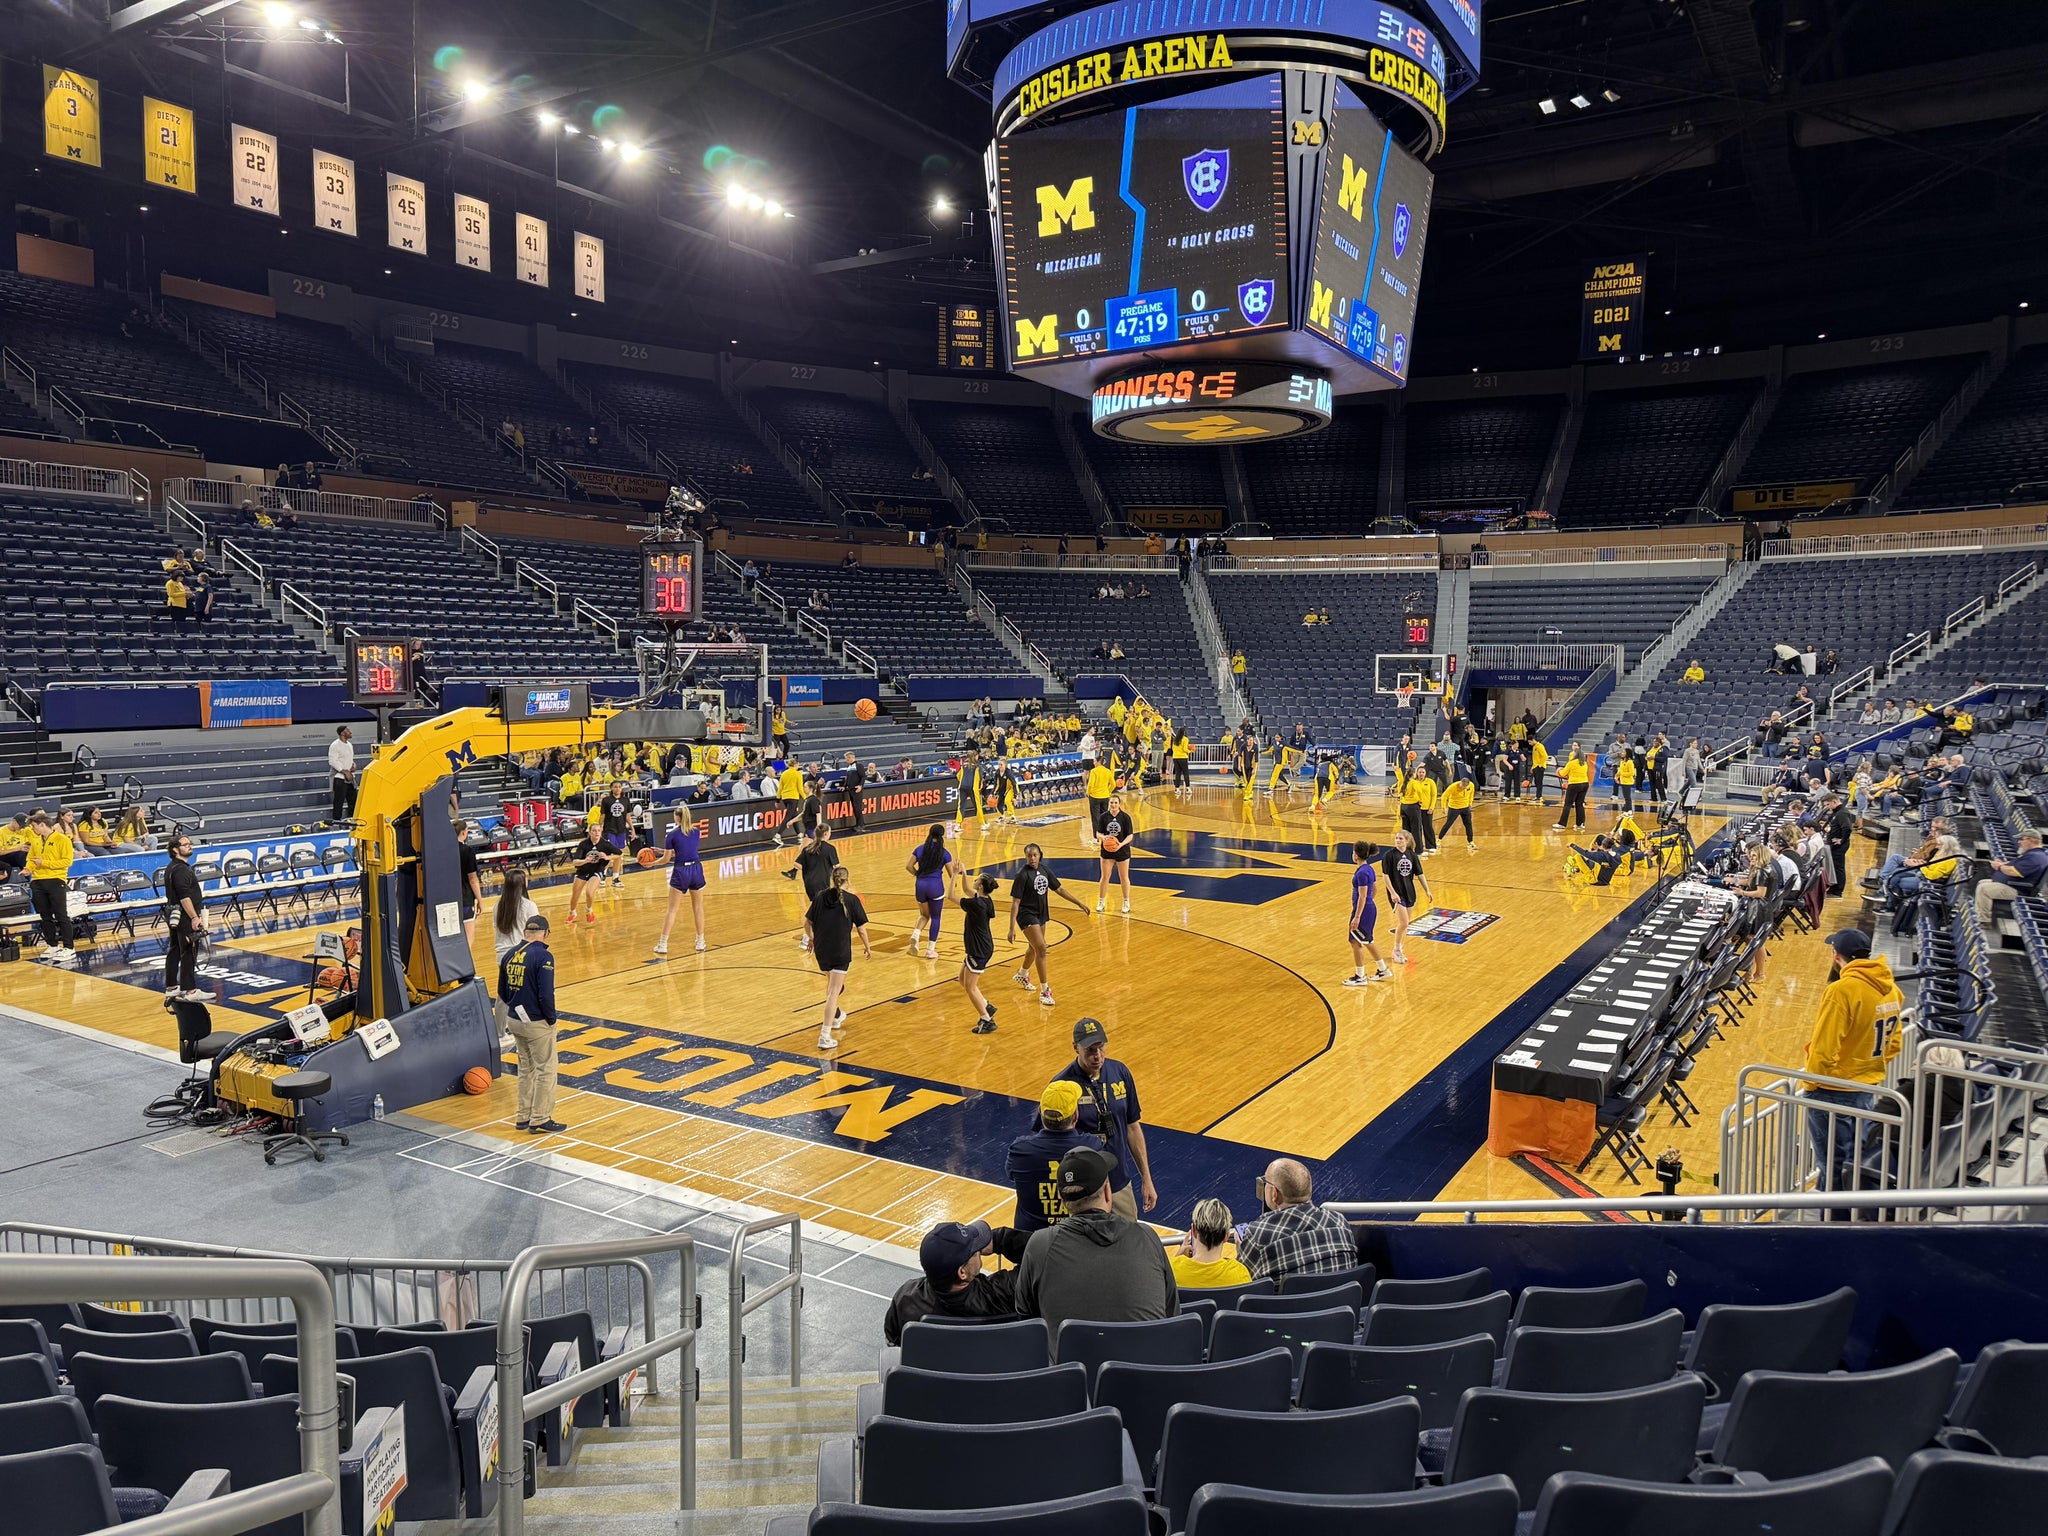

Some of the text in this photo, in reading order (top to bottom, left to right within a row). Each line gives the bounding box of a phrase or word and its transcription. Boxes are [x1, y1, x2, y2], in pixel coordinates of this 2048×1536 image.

[1020, 34, 1233, 117] CRISLER ARENA
[1370, 48, 1438, 113] CRISLER
[49, 80, 95, 101] FLAHERTY
[66, 98, 78, 116] 3
[157, 111, 181, 126] DIETZ
[160, 127, 178, 147] 21
[1292, 120, 1322, 145] M
[67, 145, 81, 158] M
[240, 136, 270, 153] BUNTIN
[246, 152, 266, 172] 22
[319, 162, 350, 178] RUSSELL
[164, 172, 178, 185] M
[326, 176, 344, 195] 33
[1337, 152, 1368, 222] M
[250, 196, 263, 208] M
[398, 198, 416, 216] 45
[1035, 176, 1096, 238] M
[458, 204, 486, 220] HUBBARD
[330, 218, 342, 229] M
[465, 218, 480, 234] 35
[526, 224, 538, 233] RICE
[402, 238, 414, 248] M
[524, 236, 538, 252] 41
[1181, 232, 1210, 250] HOLY
[1215, 224, 1255, 243] CROSS
[1334, 234, 1360, 261] MICHIGAN
[468, 256, 479, 266] M
[586, 254, 592, 268] 3
[1044, 253, 1101, 274] MICHIGAN
[528, 272, 538, 282] M
[1593, 262, 1634, 279] NCAA
[294, 280, 326, 299] 224
[1384, 270, 1408, 297] HOLY CROSS
[1584, 275, 1642, 292] CHAMPIONS
[586, 288, 594, 297] M
[1192, 289, 1206, 312] 0
[1584, 287, 1642, 299] WOMEN'S GYMNASTICS
[1120, 302, 1163, 318] PREGAME
[1309, 279, 1334, 330] M
[1339, 297, 1346, 318] 0
[428, 312, 460, 329] 225
[1076, 308, 1090, 330] 0
[1185, 316, 1210, 326] FOULS
[1594, 306, 1630, 324] 2021
[952, 320, 982, 328] CHAMPIONS
[1115, 313, 1168, 337] 47:19
[1190, 325, 1206, 335] TOL
[1015, 314, 1059, 357] M
[1070, 334, 1092, 344] FOULS
[1134, 335, 1151, 344] POSS
[1352, 323, 1372, 348] 47:19
[1380, 324, 1386, 342] 0
[1074, 344, 1089, 352] TOL
[1598, 334, 1622, 352] M
[1870, 336, 1905, 352] 233
[621, 345, 648, 360] 226
[960, 355, 974, 366] M
[790, 367, 816, 380] 227
[1661, 361, 1692, 375] 232
[963, 382, 990, 394] 228
[1473, 376, 1499, 389] 231
[1093, 370, 1196, 420] MADNESS
[624, 484, 648, 495] UNION
[630, 478, 666, 490] MICHIGAN
[1754, 488, 1794, 504] DTE
[1133, 513, 1216, 525] NISSAN
[650, 554, 692, 573] 47:19
[656, 576, 686, 612] 30
[1406, 618, 1429, 627] 47:19
[1408, 628, 1426, 642] 30
[358, 645, 403, 662] 47:19
[370, 668, 395, 692] 30
[536, 692, 558, 701] MARCH
[790, 685, 820, 694] NCAA.com
[213, 696, 288, 708] #MARCHMADNESS
[538, 700, 570, 711] MADNESS
[372, 746, 380, 754] M
[444, 740, 478, 774] M
[880, 789, 941, 811] MADNESS
[506, 964, 526, 976] EVENT
[508, 974, 524, 986] TEAM
[1085, 1022, 1097, 1031] M
[1110, 1080, 1127, 1096] M
[1041, 1199, 1071, 1216] TEA
[366, 1438, 401, 1487] NON PLAYING
[368, 1452, 401, 1502] PARTICIPANT
[373, 1474, 396, 1508] SEATING
